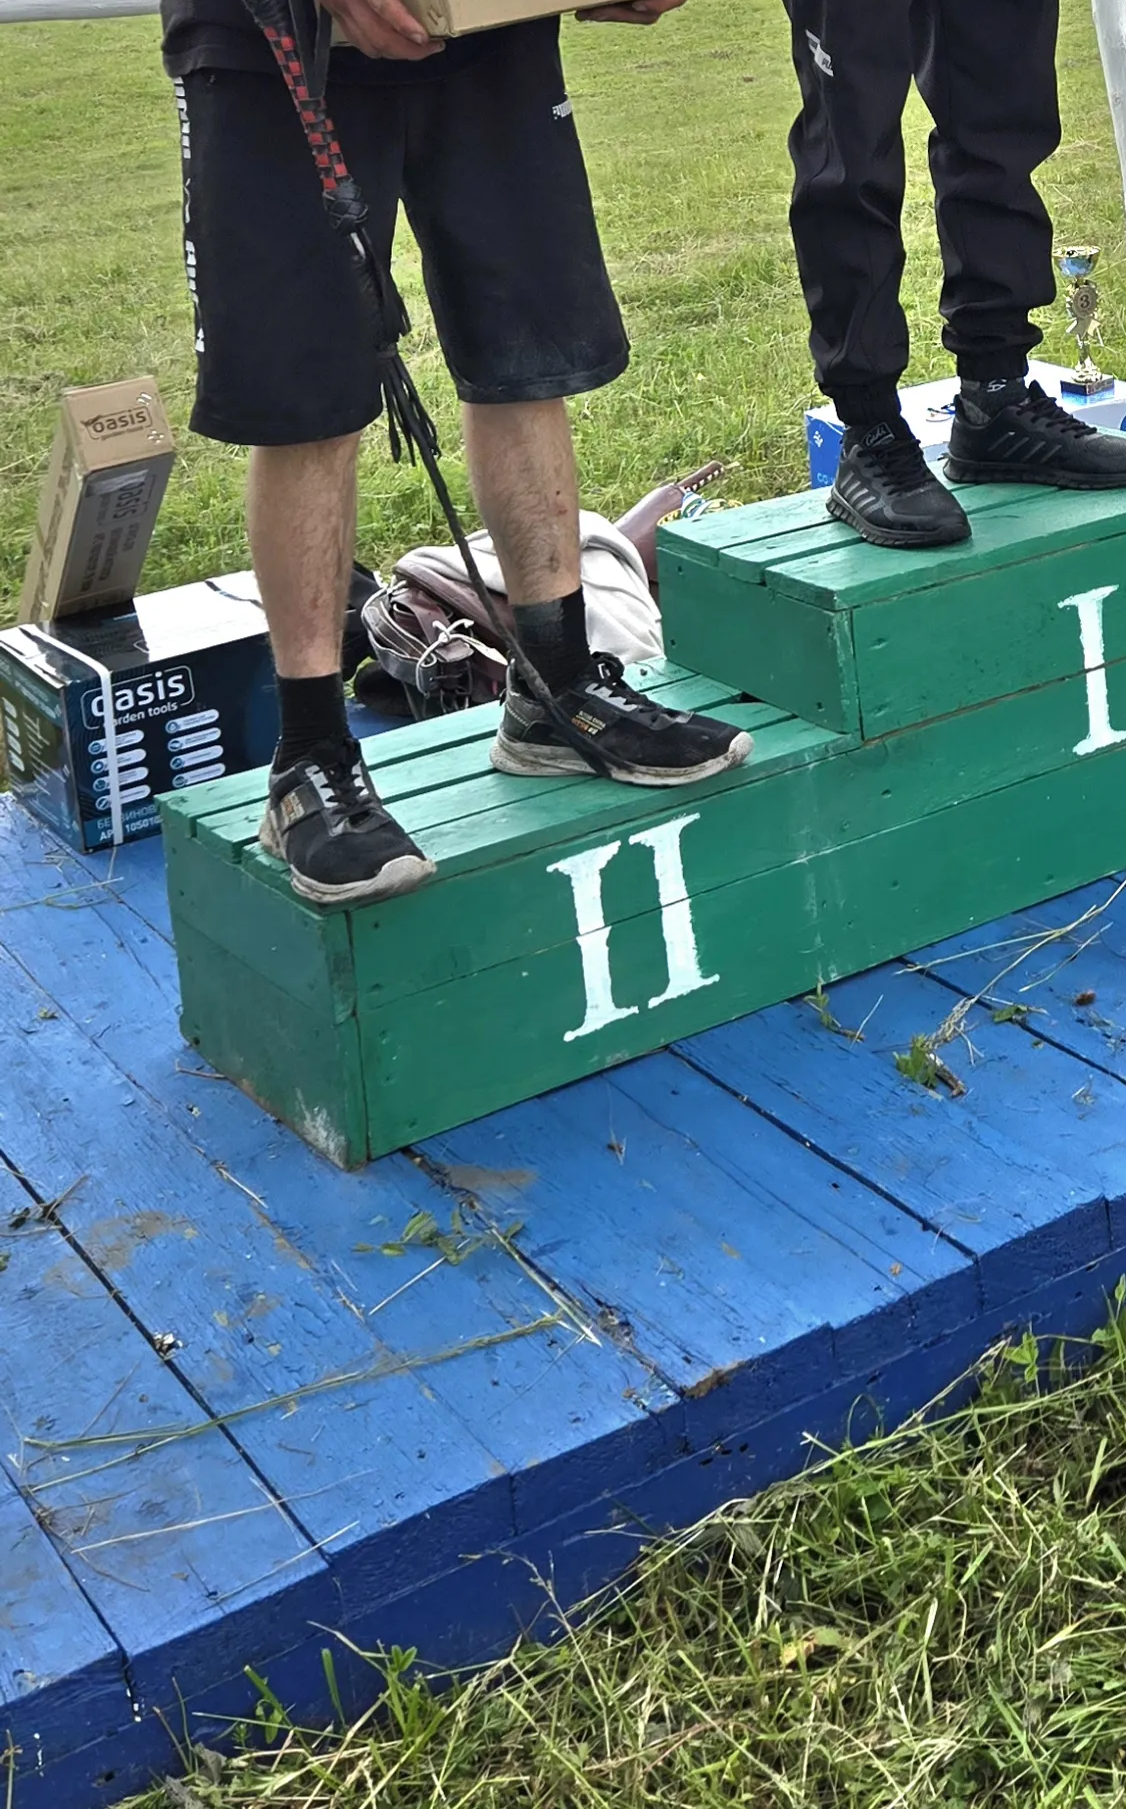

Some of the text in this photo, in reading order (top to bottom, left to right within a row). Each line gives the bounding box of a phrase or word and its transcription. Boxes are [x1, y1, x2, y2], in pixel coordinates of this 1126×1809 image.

[1080, 294, 1090, 309] 3
[92, 408, 147, 434] oasis
[148, 701, 178, 717] tools
[546, 812, 721, 1043] II
